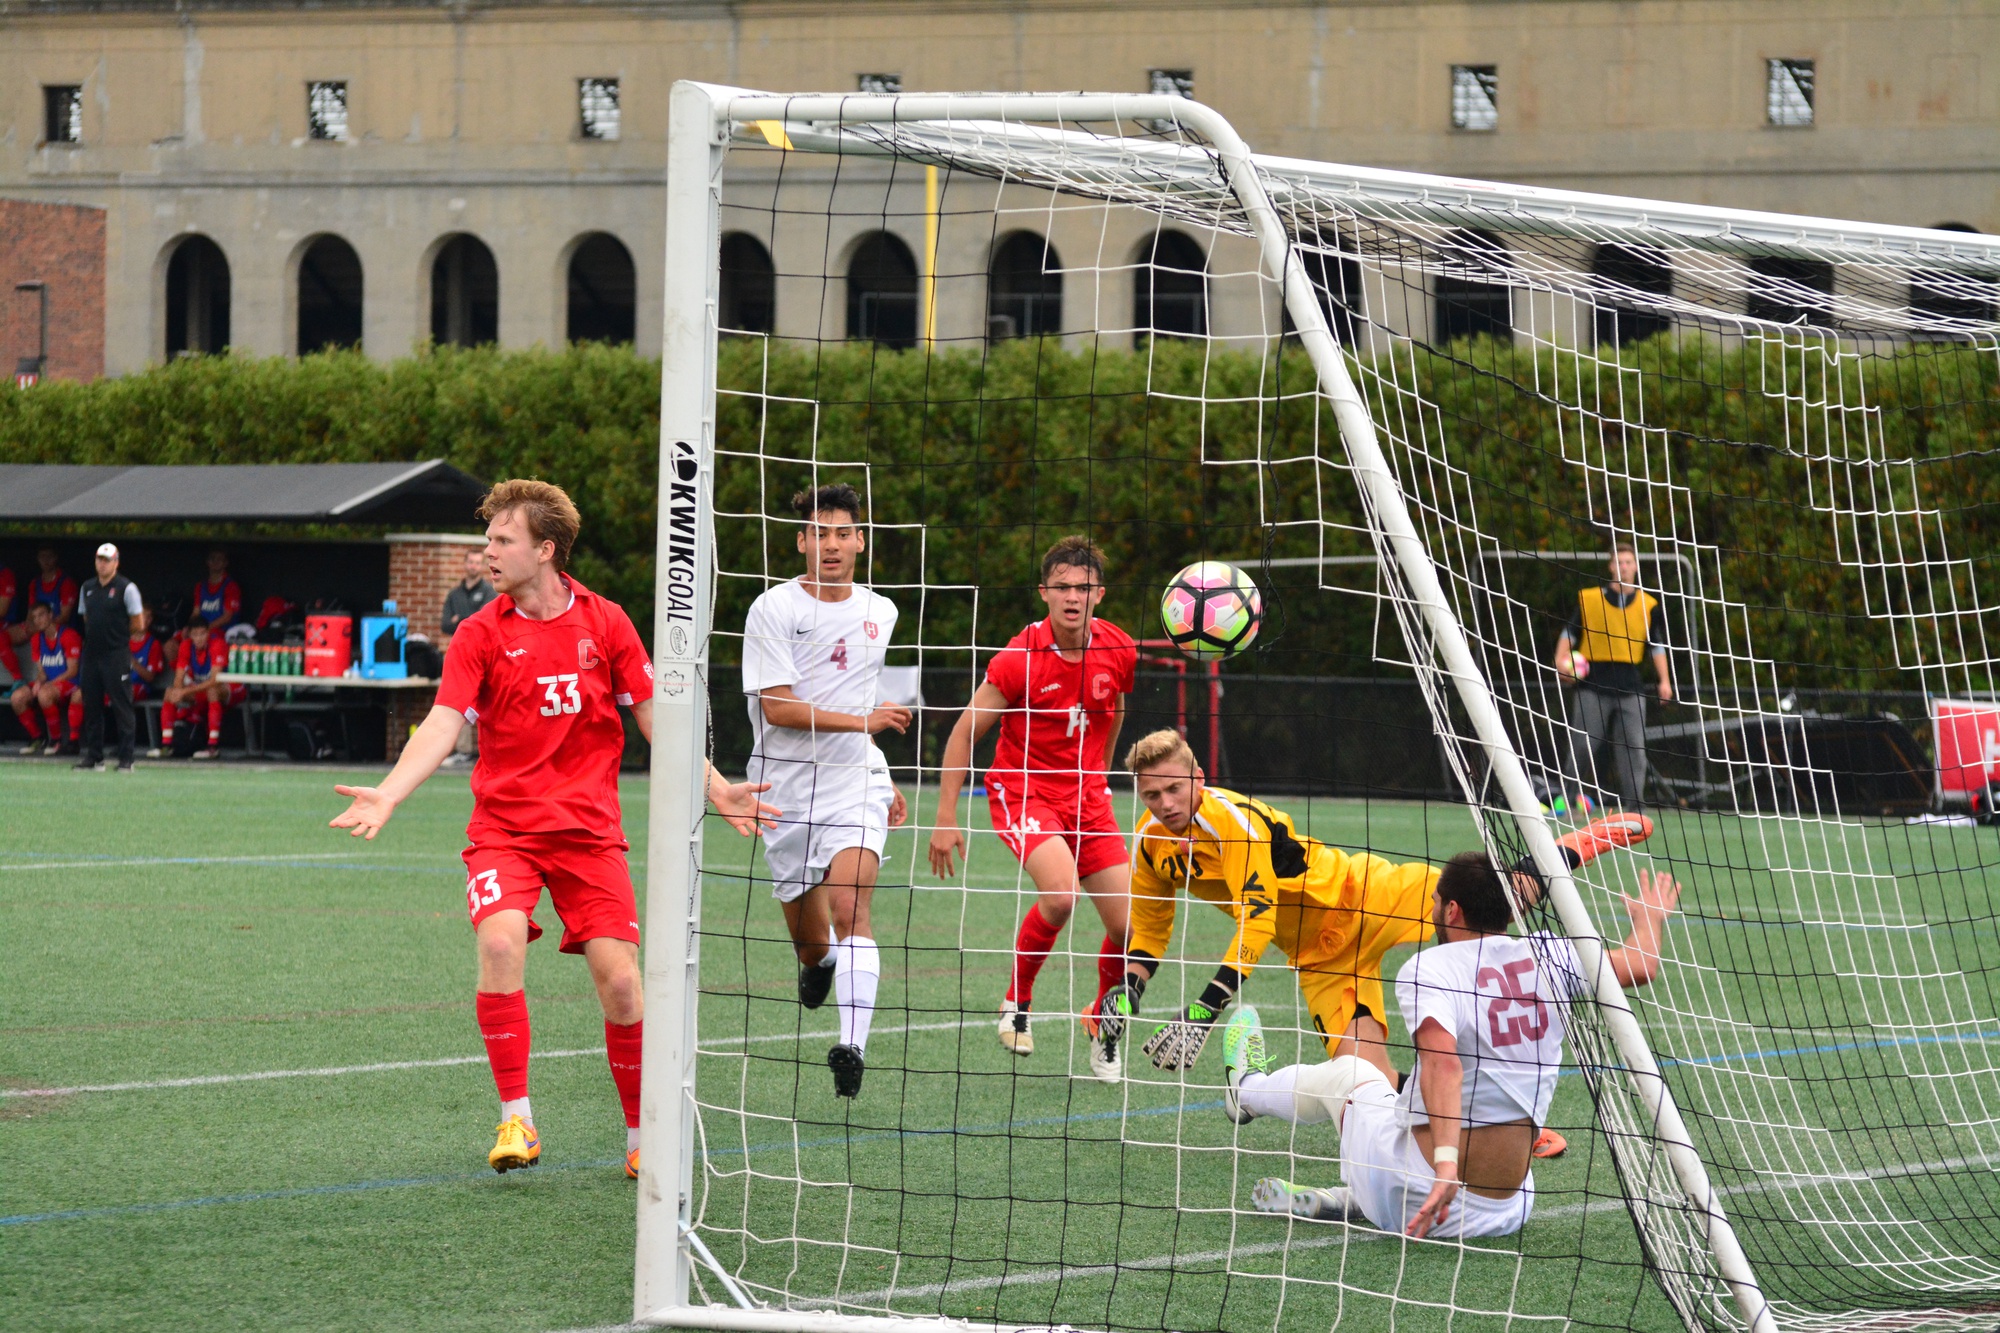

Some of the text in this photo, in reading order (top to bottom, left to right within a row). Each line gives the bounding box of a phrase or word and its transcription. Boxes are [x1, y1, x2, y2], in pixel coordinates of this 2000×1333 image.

[578, 639, 599, 670] C
[830, 638, 847, 670] 4
[537, 673, 582, 717] 33
[1092, 673, 1110, 700] C
[467, 869, 502, 918] 33
[1477, 958, 1549, 1048] 25
